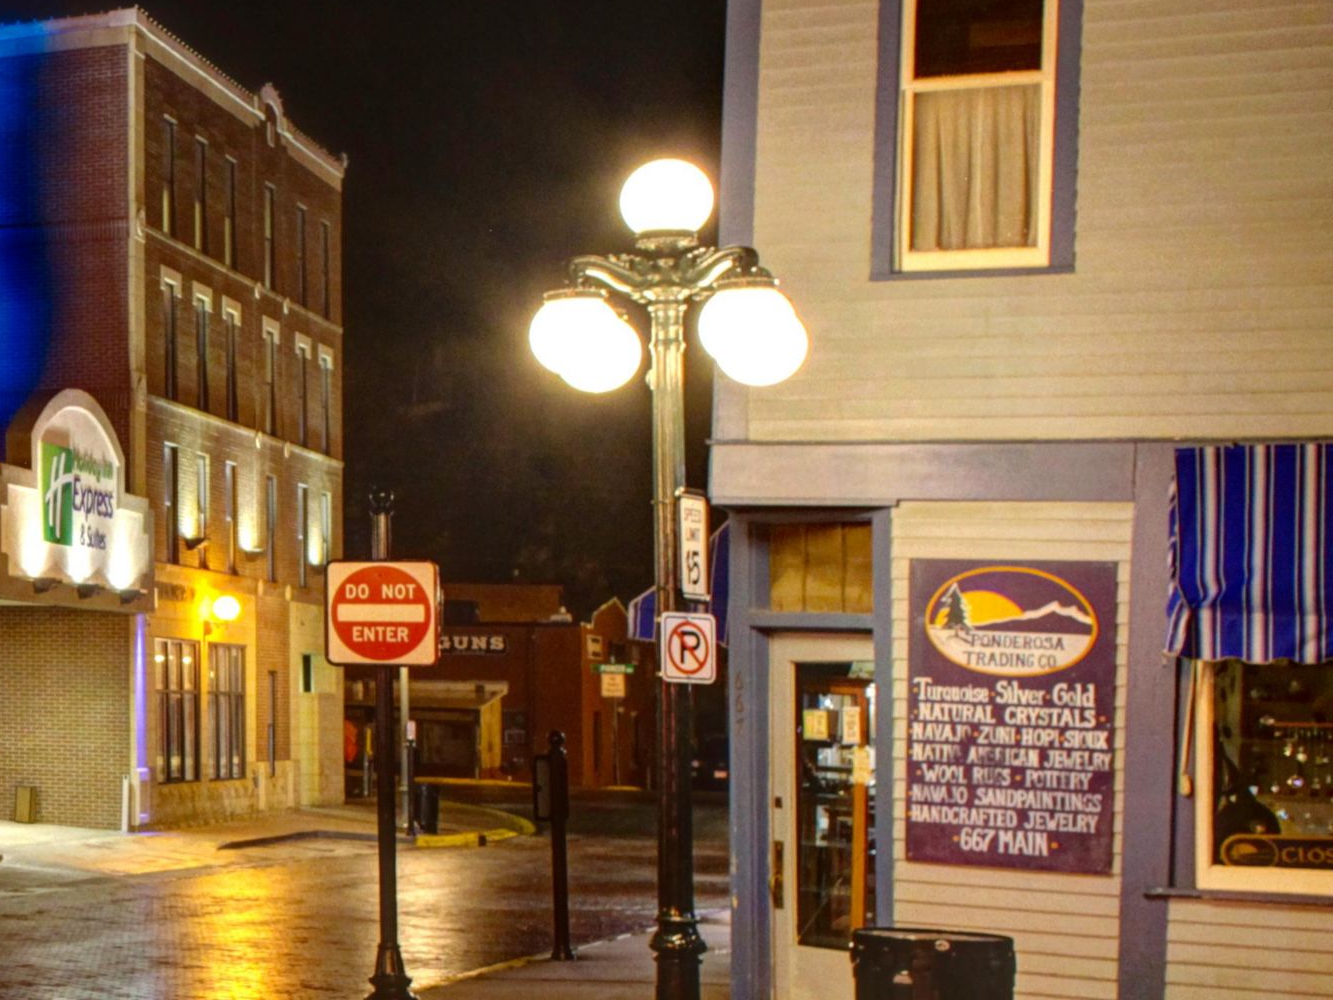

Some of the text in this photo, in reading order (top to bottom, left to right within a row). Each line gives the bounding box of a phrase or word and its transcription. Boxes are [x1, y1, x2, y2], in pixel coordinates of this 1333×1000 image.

[73, 475, 113, 521] Express
[87, 525, 106, 550] Suites
[686, 551, 701, 585] 15
[345, 583, 416, 599] DO NOT
[352, 626, 409, 642] ENTER
[439, 635, 505, 651] GUNS
[971, 633, 1065, 651] PONDEROSA
[964, 651, 1034, 668] TRADING
[913, 677, 1095, 708] Turquoise Silver Gold
[918, 702, 1097, 729] NATURAL CRYSTALS
[977, 725, 1016, 746] ZUNI
[1021, 728, 1061, 747] HOPI
[1064, 730, 1109, 749] SIOUX
[1044, 750, 1112, 771] JEWELRY
[921, 763, 1093, 791] WOOL RUGS POTTERY
[911, 784, 1103, 813] NAVAJO SANDPAINTINGS
[911, 804, 1100, 834] HANDCRAFTED JEWELRY
[959, 827, 1049, 857] 667 MAIN
